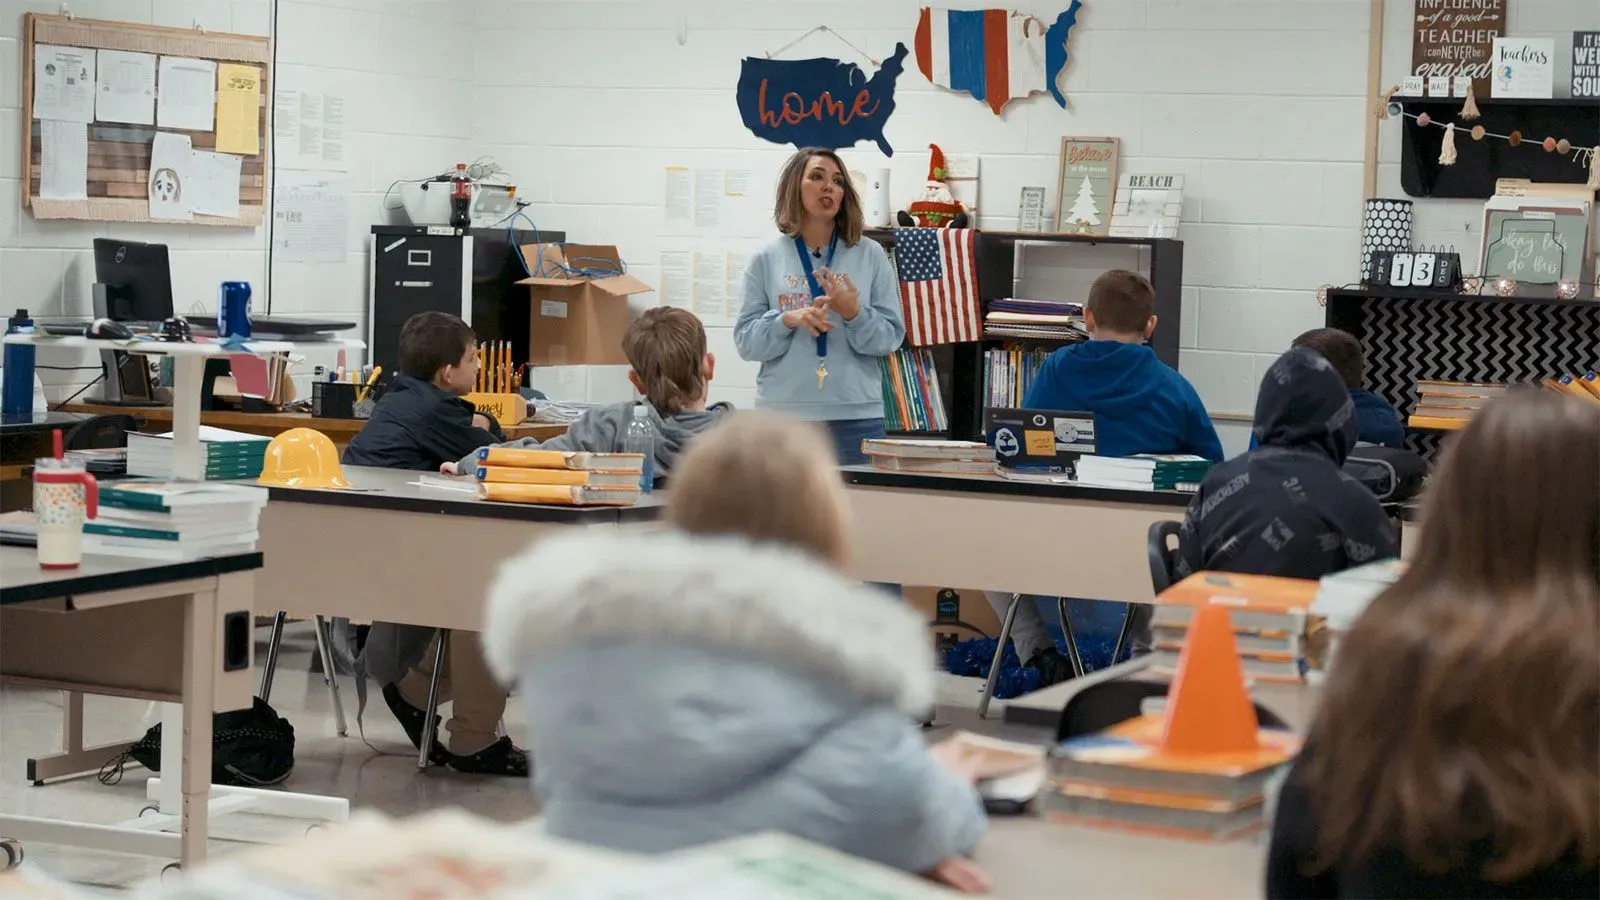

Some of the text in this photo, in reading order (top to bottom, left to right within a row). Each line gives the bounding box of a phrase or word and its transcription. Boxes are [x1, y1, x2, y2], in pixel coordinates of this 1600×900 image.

[1419, 0, 1501, 9] INFLUENCE
[1427, 9, 1486, 28] of a good
[1418, 28, 1498, 44] TEACHER
[1583, 34, 1593, 47] IT
[1441, 45, 1472, 60] NEVER
[1500, 45, 1548, 65] Teachers
[1415, 55, 1493, 79] erased
[1574, 65, 1596, 77] WITH
[758, 78, 880, 129] home
[1129, 175, 1173, 188] BEACH
[1507, 250, 1559, 275] do this
